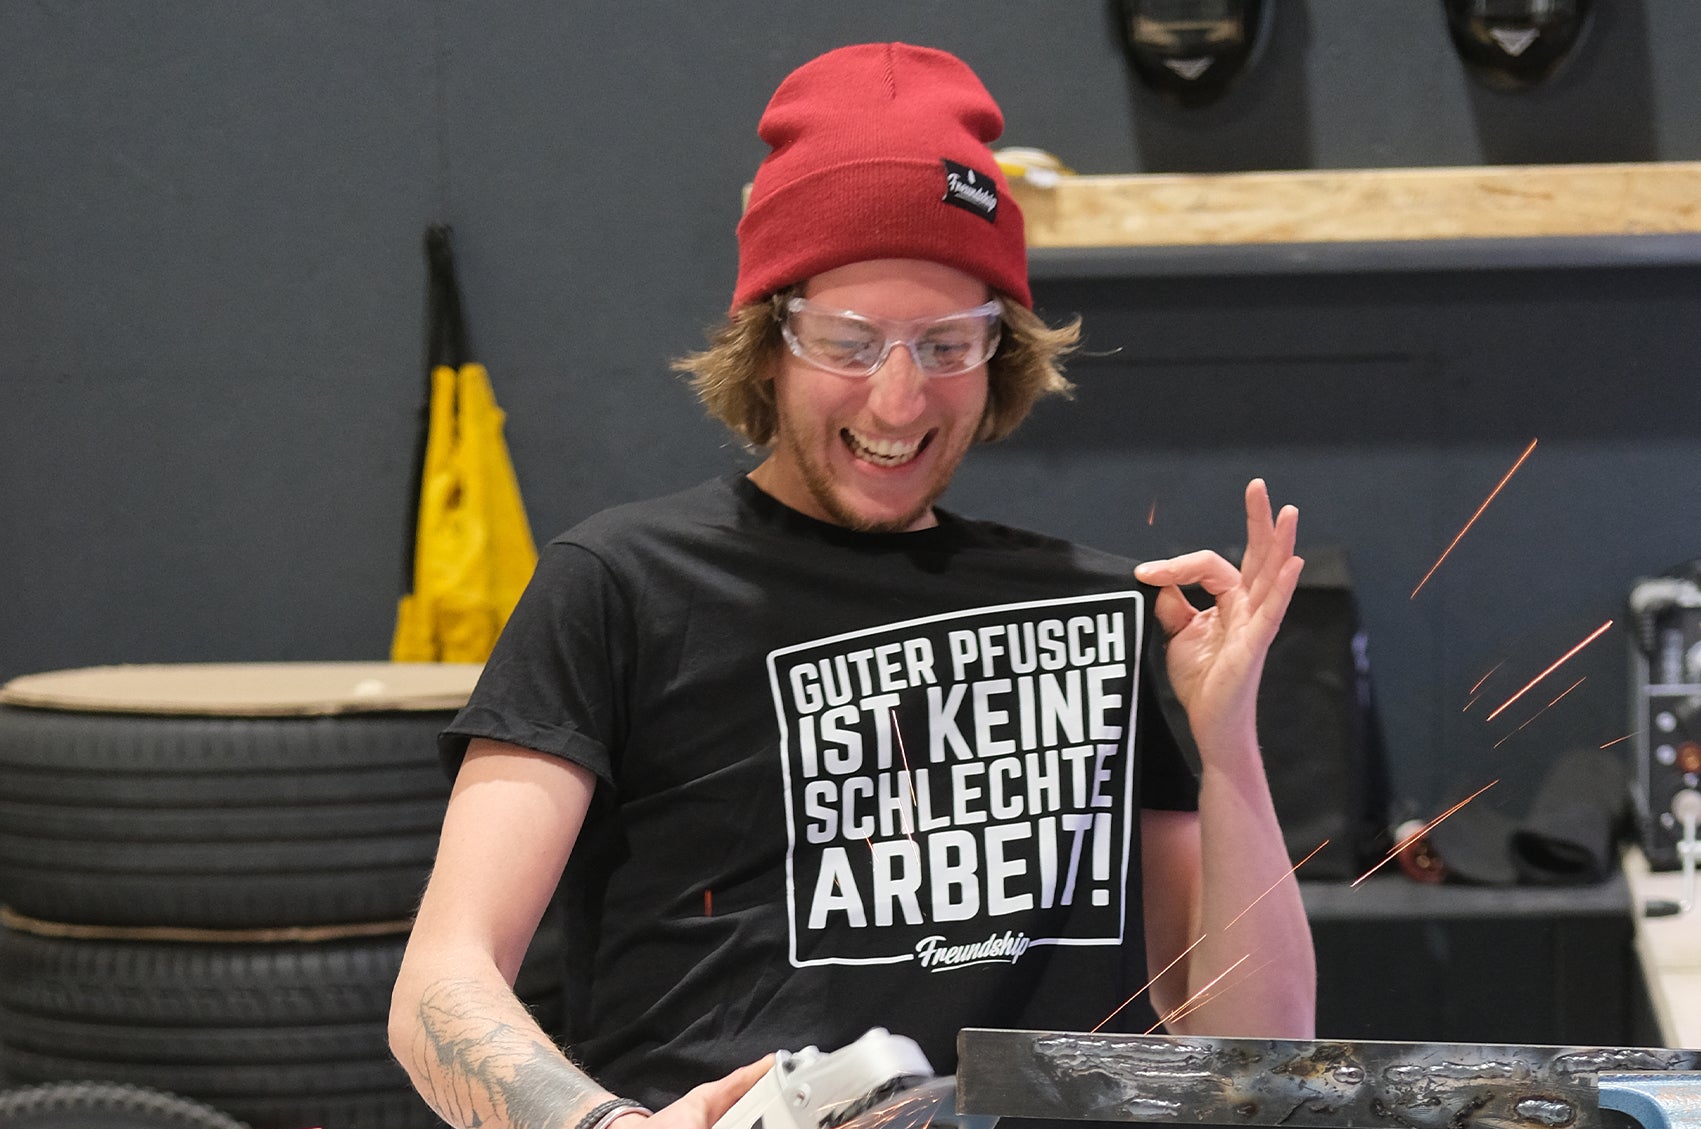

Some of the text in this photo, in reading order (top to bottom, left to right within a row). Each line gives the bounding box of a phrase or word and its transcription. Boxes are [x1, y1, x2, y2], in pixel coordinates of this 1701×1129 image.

[789, 612, 1126, 715] GUTER PFUSCH
[798, 664, 1127, 778] IST KEINE
[804, 743, 1118, 844] SCHLECHTE
[807, 812, 1113, 929] ARBEIT!
[914, 930, 1031, 969] Freundship
